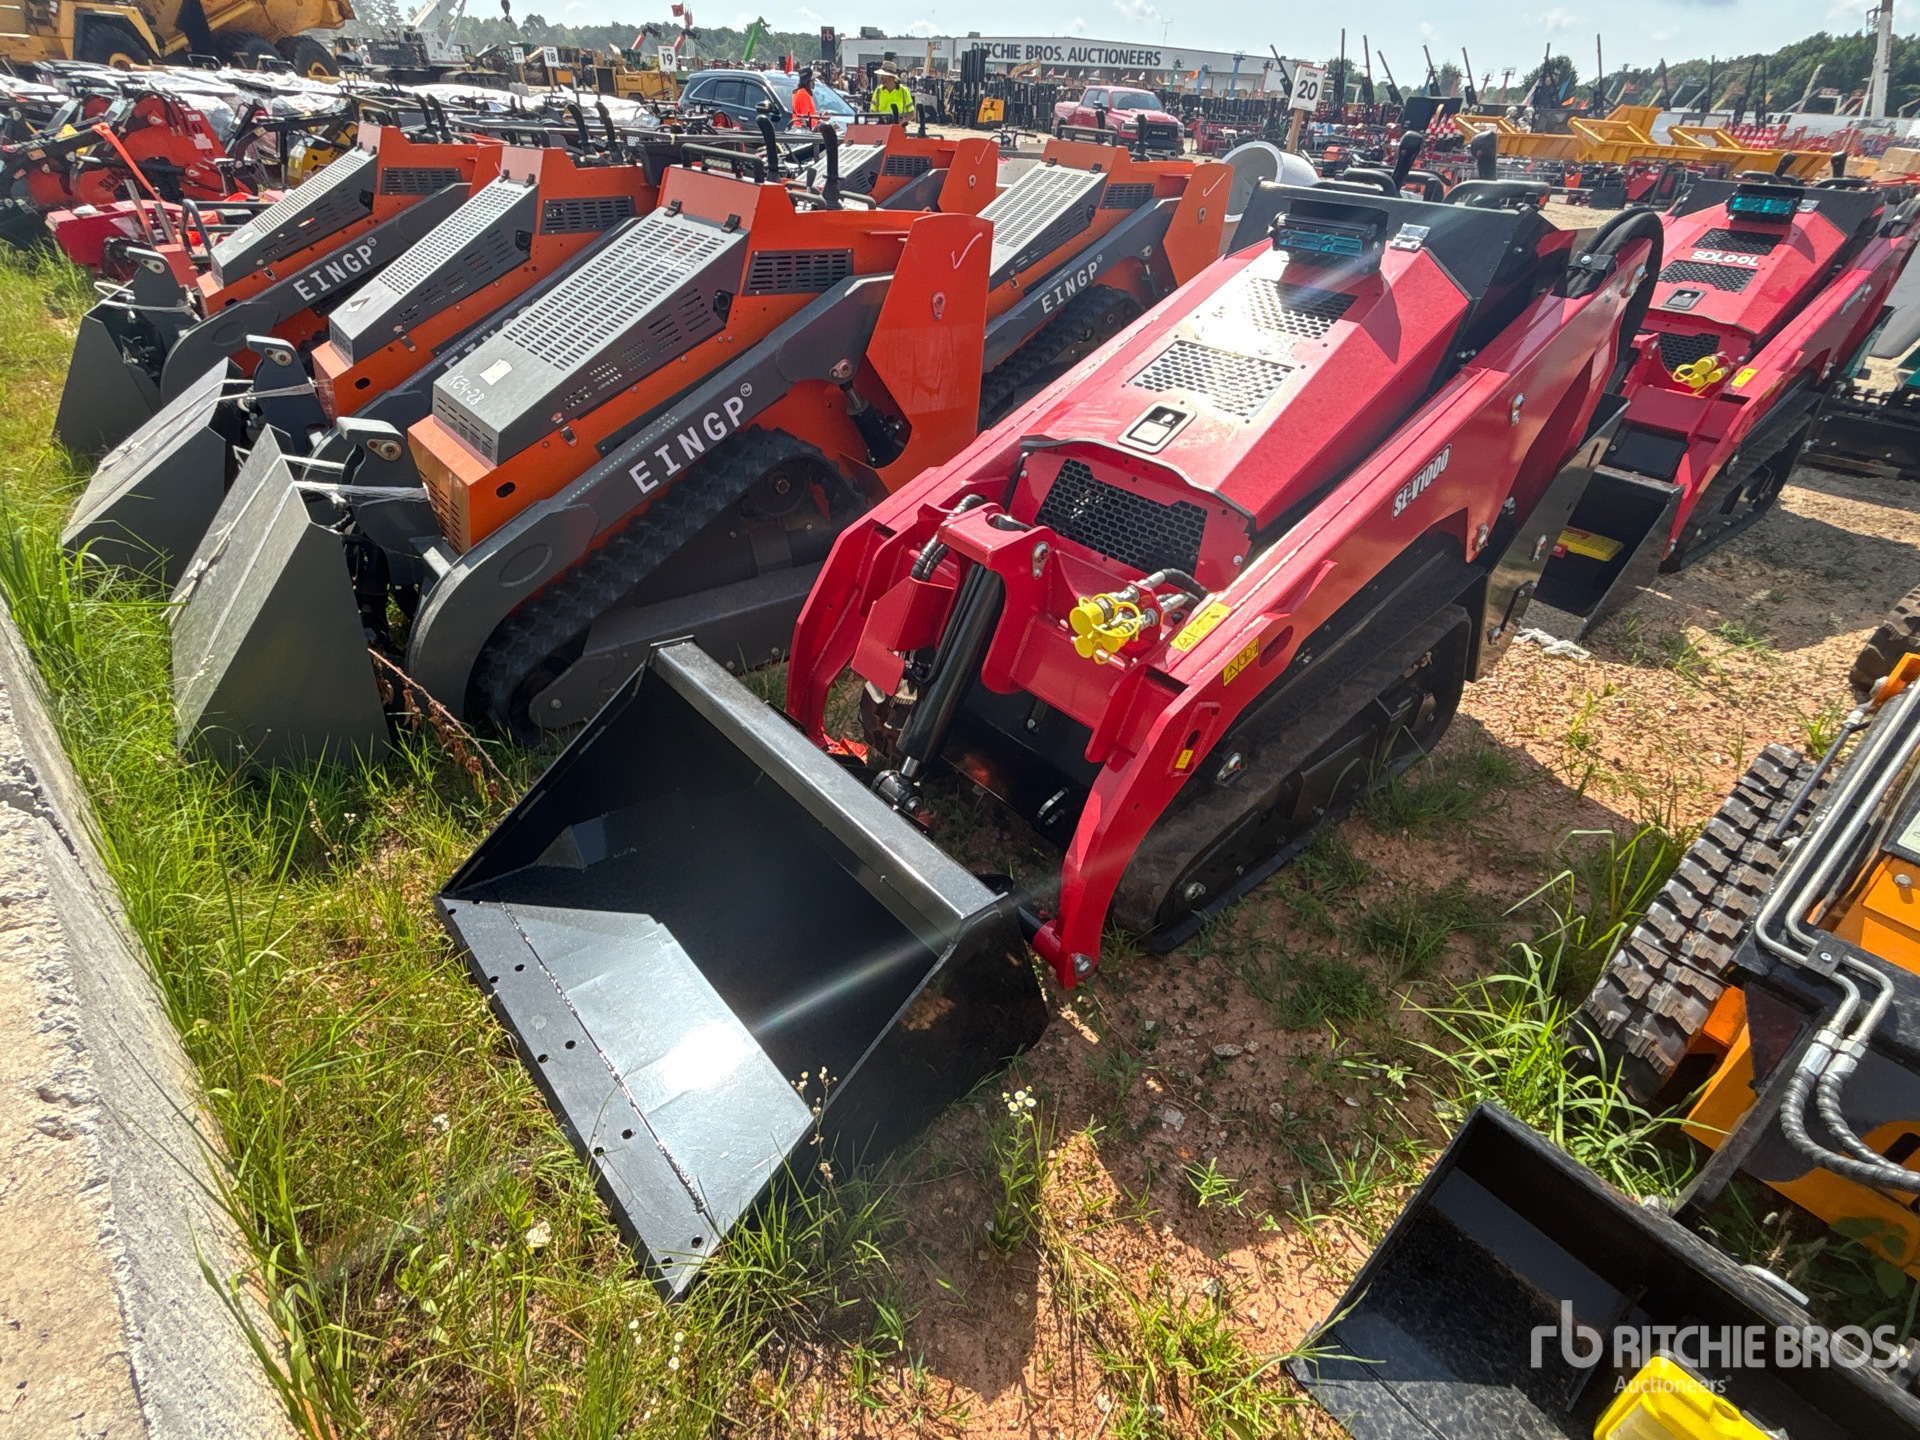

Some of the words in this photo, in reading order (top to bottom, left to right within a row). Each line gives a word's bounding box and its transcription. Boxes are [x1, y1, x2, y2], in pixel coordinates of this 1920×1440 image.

[546, 52, 557, 63] 18
[661, 53, 674, 66] 19
[1025, 44, 1065, 62] BROS.
[1067, 46, 1162, 67] AUCTIONEERS
[1305, 70, 1318, 78] Lane
[1296, 79, 1319, 101] 20
[1690, 250, 1760, 267] SDLOOL
[292, 244, 373, 302] EINGP
[1041, 261, 1099, 315] EINGP
[628, 396, 745, 495] EINGP
[1393, 447, 1450, 518] SL-V1000
